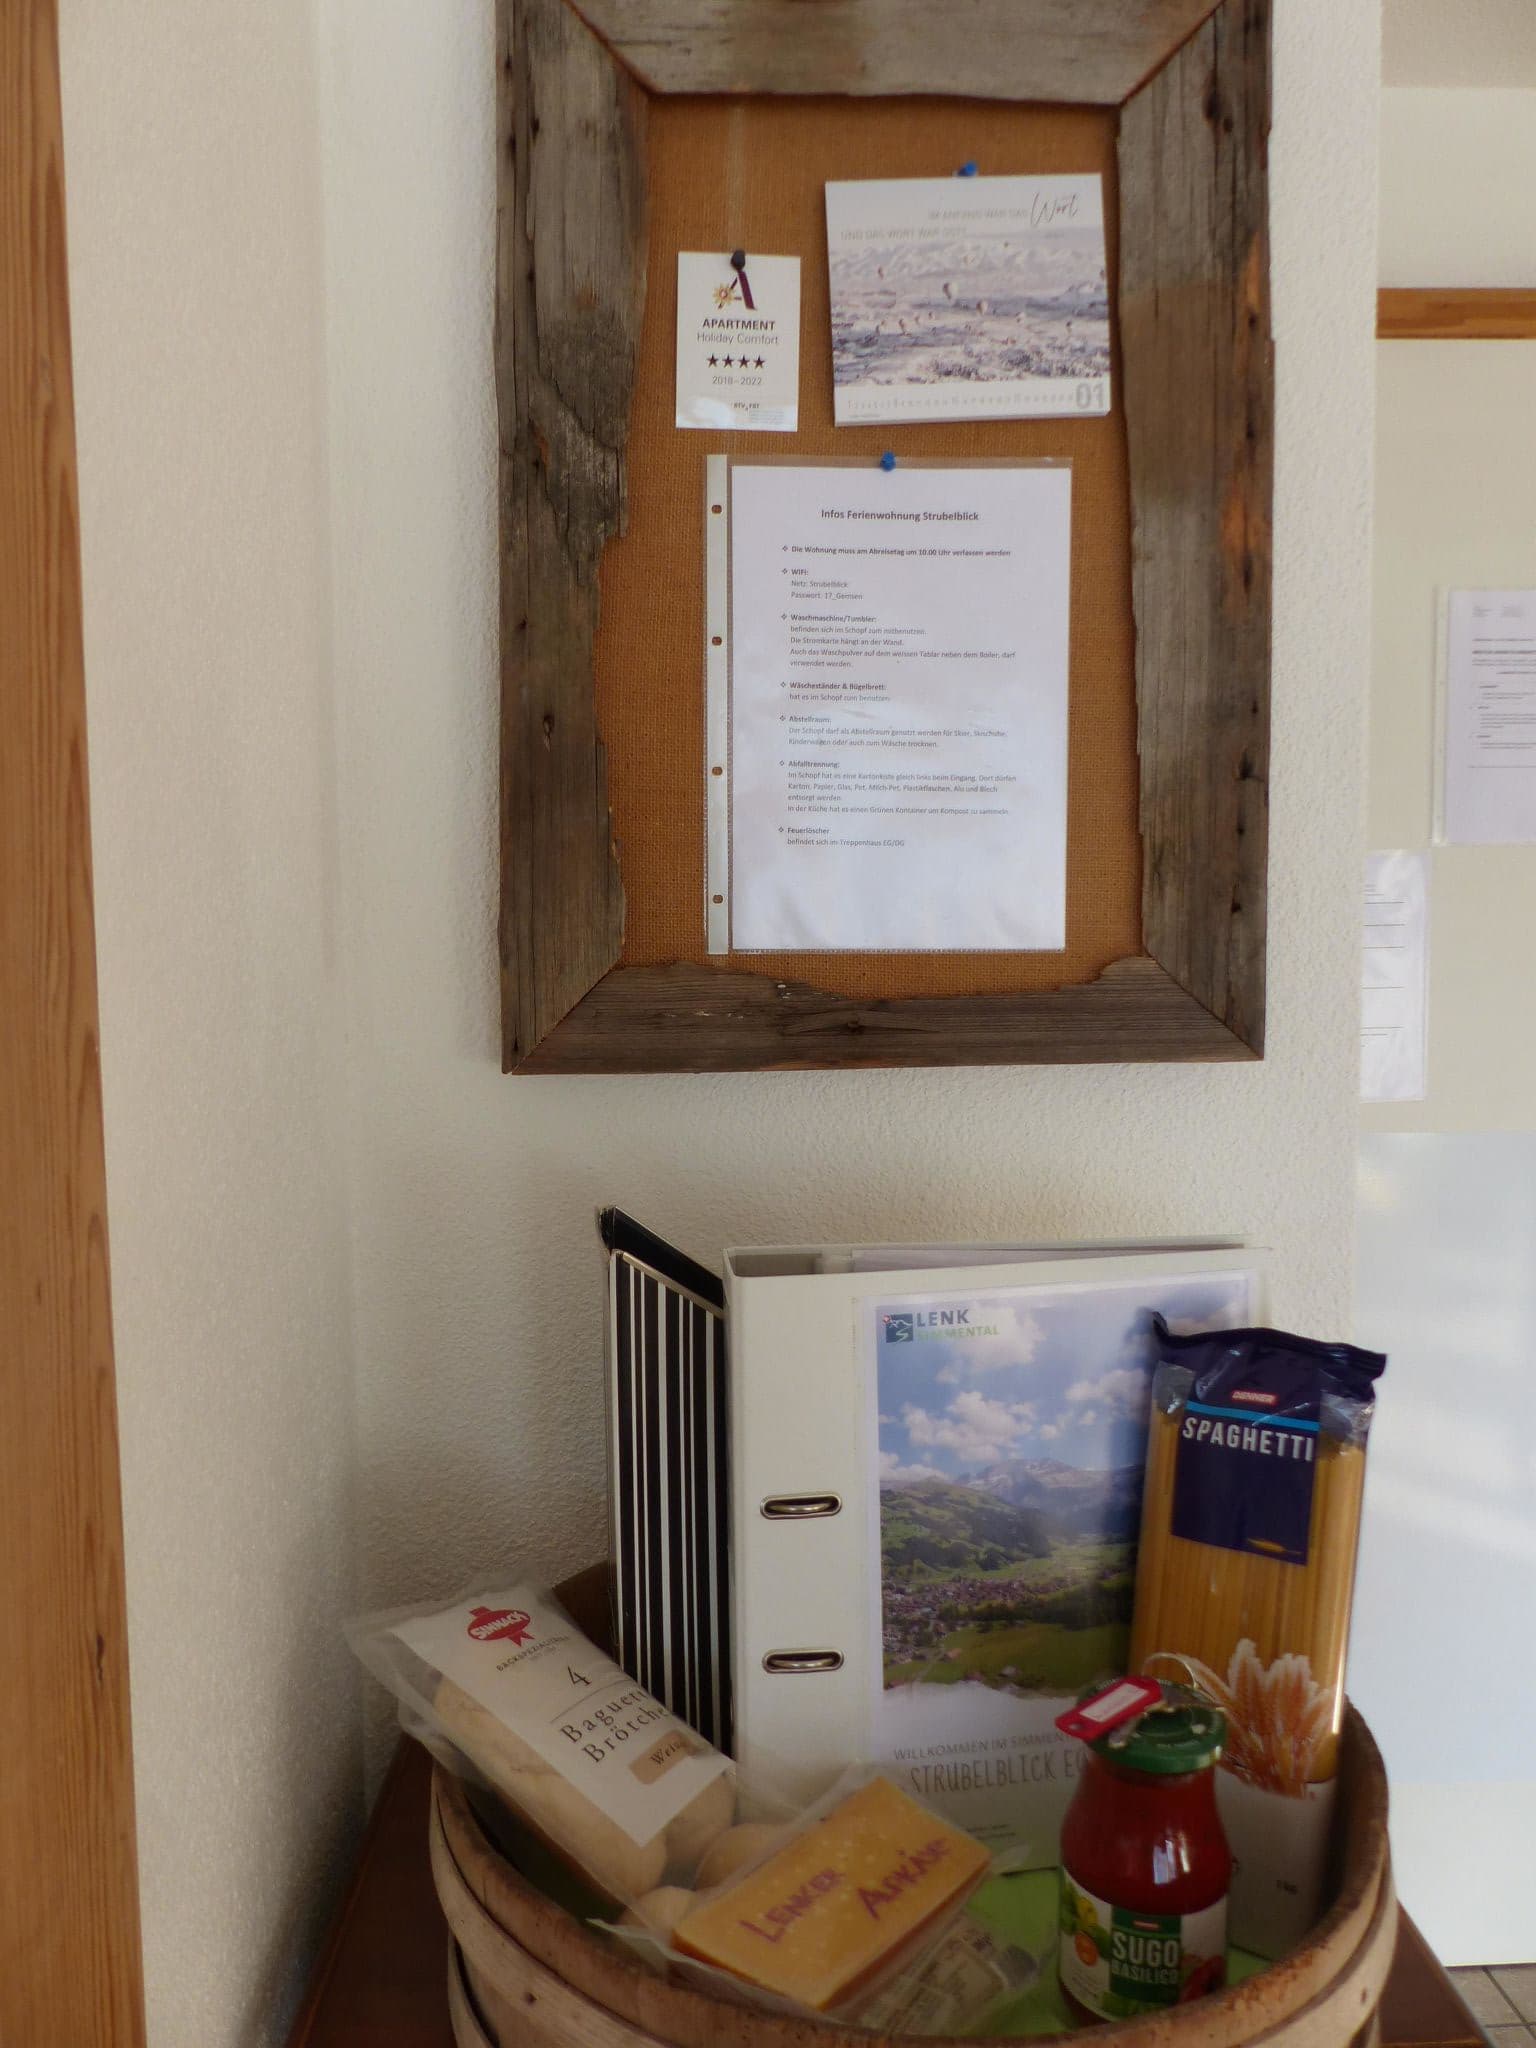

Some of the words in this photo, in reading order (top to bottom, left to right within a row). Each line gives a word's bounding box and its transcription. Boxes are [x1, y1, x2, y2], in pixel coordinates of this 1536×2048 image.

[702, 317, 776, 331] APARTMENT
[696, 332, 734, 346] Holiday
[736, 333, 779, 346] Comfort
[1074, 382, 1105, 409] 01
[821, 509, 845, 519] Infos
[847, 510, 921, 522] Ferienwohnung
[922, 511, 979, 521] Strubelblick
[804, 546, 837, 555] Wohnung
[868, 546, 904, 556] Abreisetag
[919, 547, 937, 555] 10.00
[790, 625, 820, 633] befinden
[844, 626, 867, 635] Schopf
[802, 636, 840, 644] Stromkarte
[840, 637, 859, 646] hängt
[790, 648, 806, 656] Auch
[821, 648, 863, 658] Waschpulver
[876, 649, 891, 657] dem
[789, 681, 840, 689] Wäscheständer
[820, 693, 842, 702] Schopf
[916, 1308, 970, 1327] LENK
[1182, 1416, 1315, 1462] SPAGHETTI
[471, 1610, 530, 1640] SINNACK
[567, 1665, 593, 1688] 4
[894, 1739, 989, 1761] WILLKOMMEN
[910, 1752, 1056, 1793] STRUBELBLICK
[1112, 1931, 1179, 1967] SUGO
